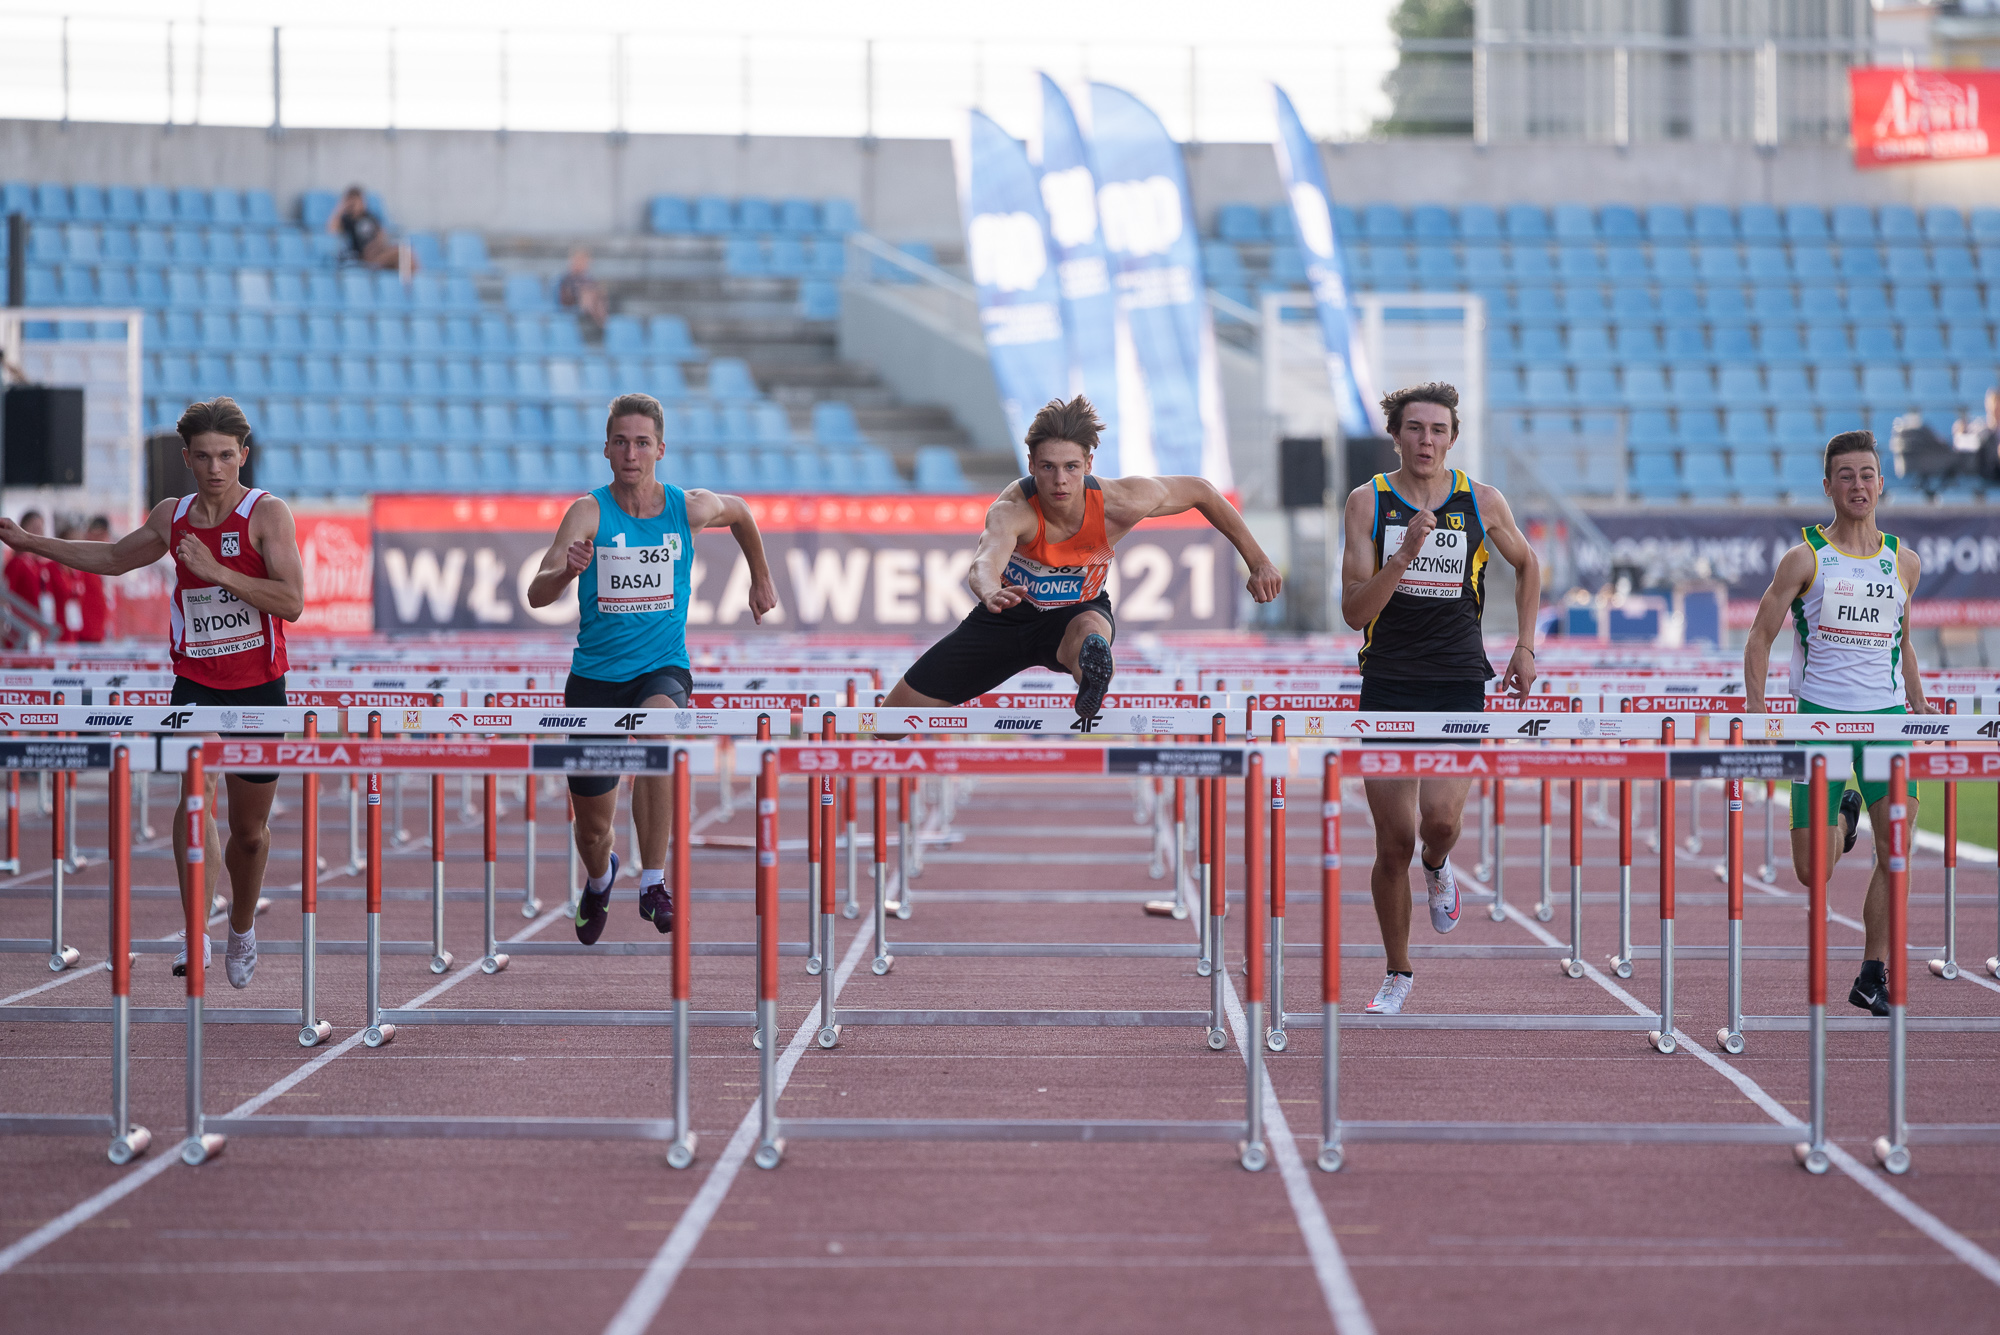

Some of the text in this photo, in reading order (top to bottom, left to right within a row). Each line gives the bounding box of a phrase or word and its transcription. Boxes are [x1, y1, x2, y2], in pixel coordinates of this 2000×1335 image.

[1435, 532, 1458, 548] 80
[639, 548, 670, 564] 363
[1387, 554, 1463, 575] ERZYŃSKI
[610, 573, 661, 590] BASAJ
[1005, 564, 1081, 595] KAMIONEK
[1395, 584, 1458, 597] OCŁAWEK 2021
[1866, 583, 1894, 599] 191
[601, 601, 670, 612] WŁOCŁAWEK 2021
[1838, 605, 1880, 623] FILAR
[193, 608, 251, 633] BYDOŃ
[190, 638, 260, 657] WŁOCŁAWEK 2021
[1822, 632, 1888, 648] WŁOCŁAWEK 2021
[287, 693, 325, 706] ex.PL
[1012, 695, 1074, 708] renex.
[1279, 696, 1356, 708] renex.PL
[1652, 698, 1729, 711] renex.PL
[22, 715, 57, 724] ORLEN
[85, 715, 134, 726] 4MOVE
[160, 711, 194, 729] 4F
[475, 716, 510, 725] ORLEN
[538, 717, 588, 727] 4MOVE
[614, 713, 648, 731] 4F
[930, 718, 966, 727] ORLEN
[994, 719, 1043, 730] 4MOVE
[1070, 716, 1104, 733] 4F
[1377, 722, 1413, 731] ORLEN
[1441, 723, 1490, 734] 4MOVE
[1517, 719, 1551, 737] 4F
[1837, 723, 1873, 733] ORLEN
[1901, 725, 1950, 735] 4MOVE
[222, 744, 351, 764] 53. PZLA
[798, 751, 927, 770] 53. PZLA
[1359, 752, 1489, 774] 53. PZLA
[1929, 754, 1976, 775] 53.
[371, 771, 379, 792] polan
[1275, 776, 1283, 796] polan
[1733, 778, 1742, 798] polan
